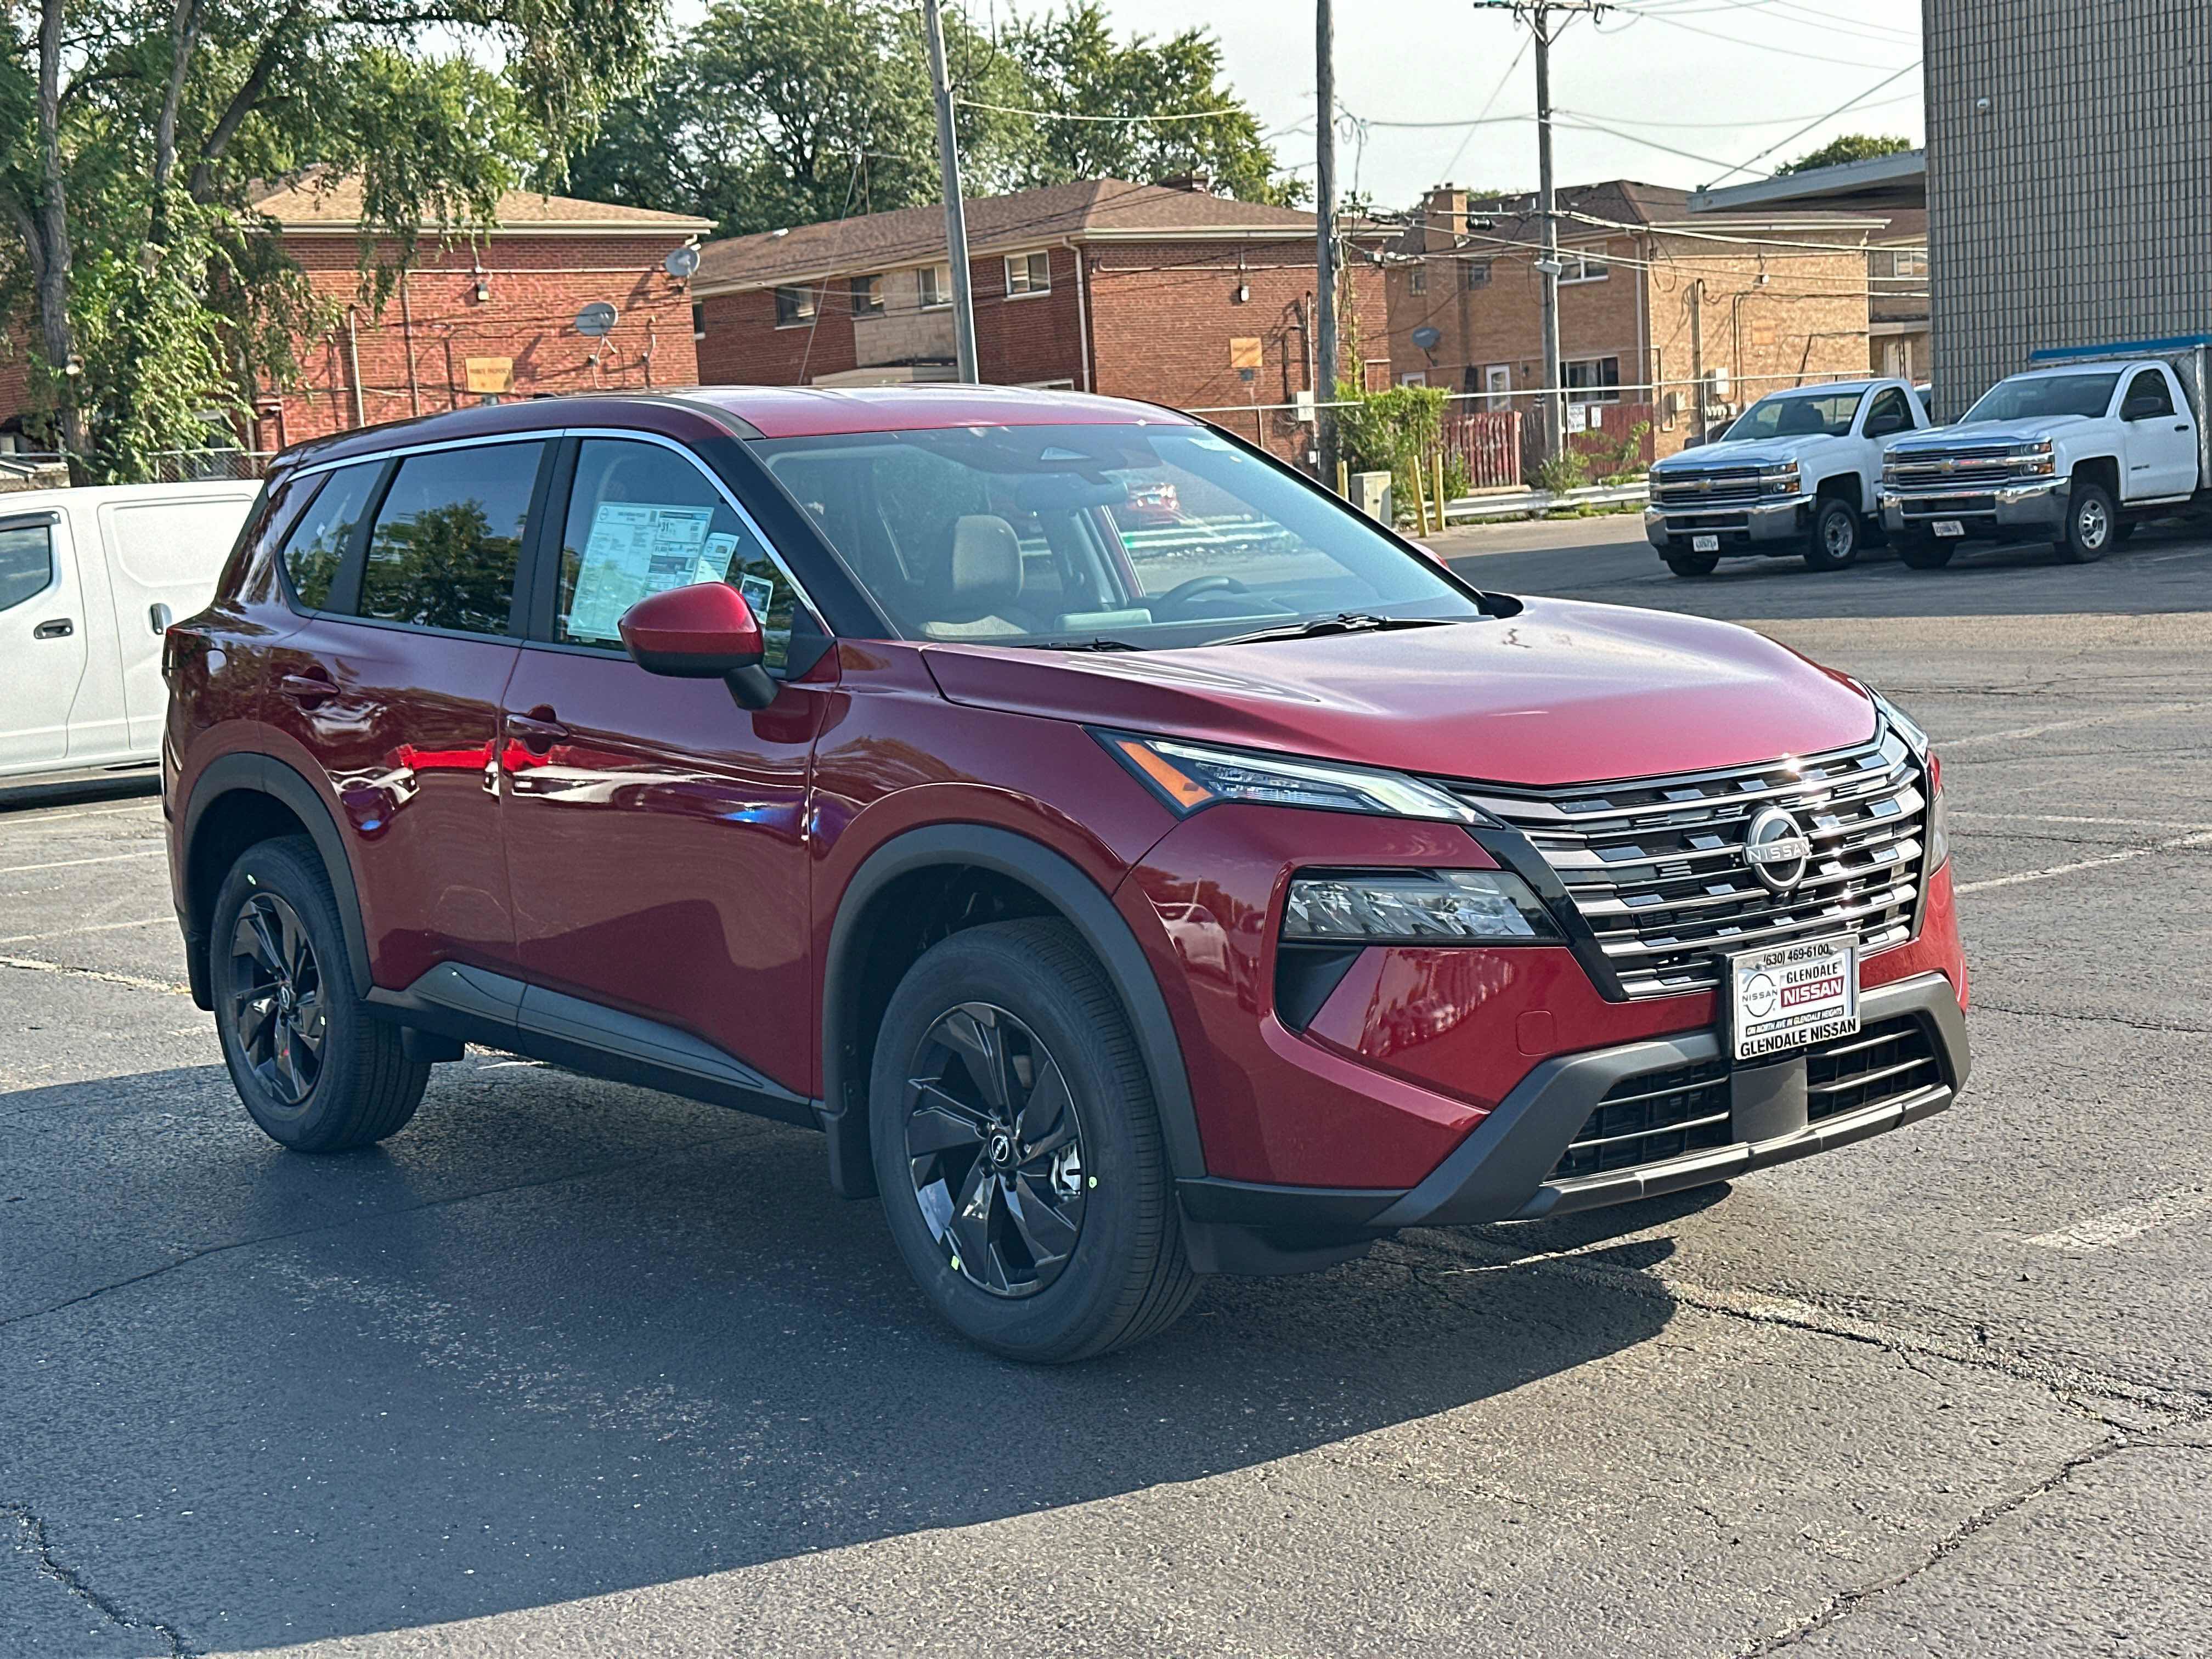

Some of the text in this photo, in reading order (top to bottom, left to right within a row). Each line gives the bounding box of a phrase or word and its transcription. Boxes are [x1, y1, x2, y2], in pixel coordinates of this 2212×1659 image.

[1748, 842, 1809, 862] NISSAN
[1764, 943, 1829, 966] (630) 469-6100
[1786, 962, 1838, 984] GLENDALE
[1742, 989, 1778, 1002] NISSAN
[1784, 979, 1843, 1006] NISSAN
[1793, 1012, 1821, 1024] GLENDALE
[1740, 1018, 1857, 1057] GLENDALE NISSAN
